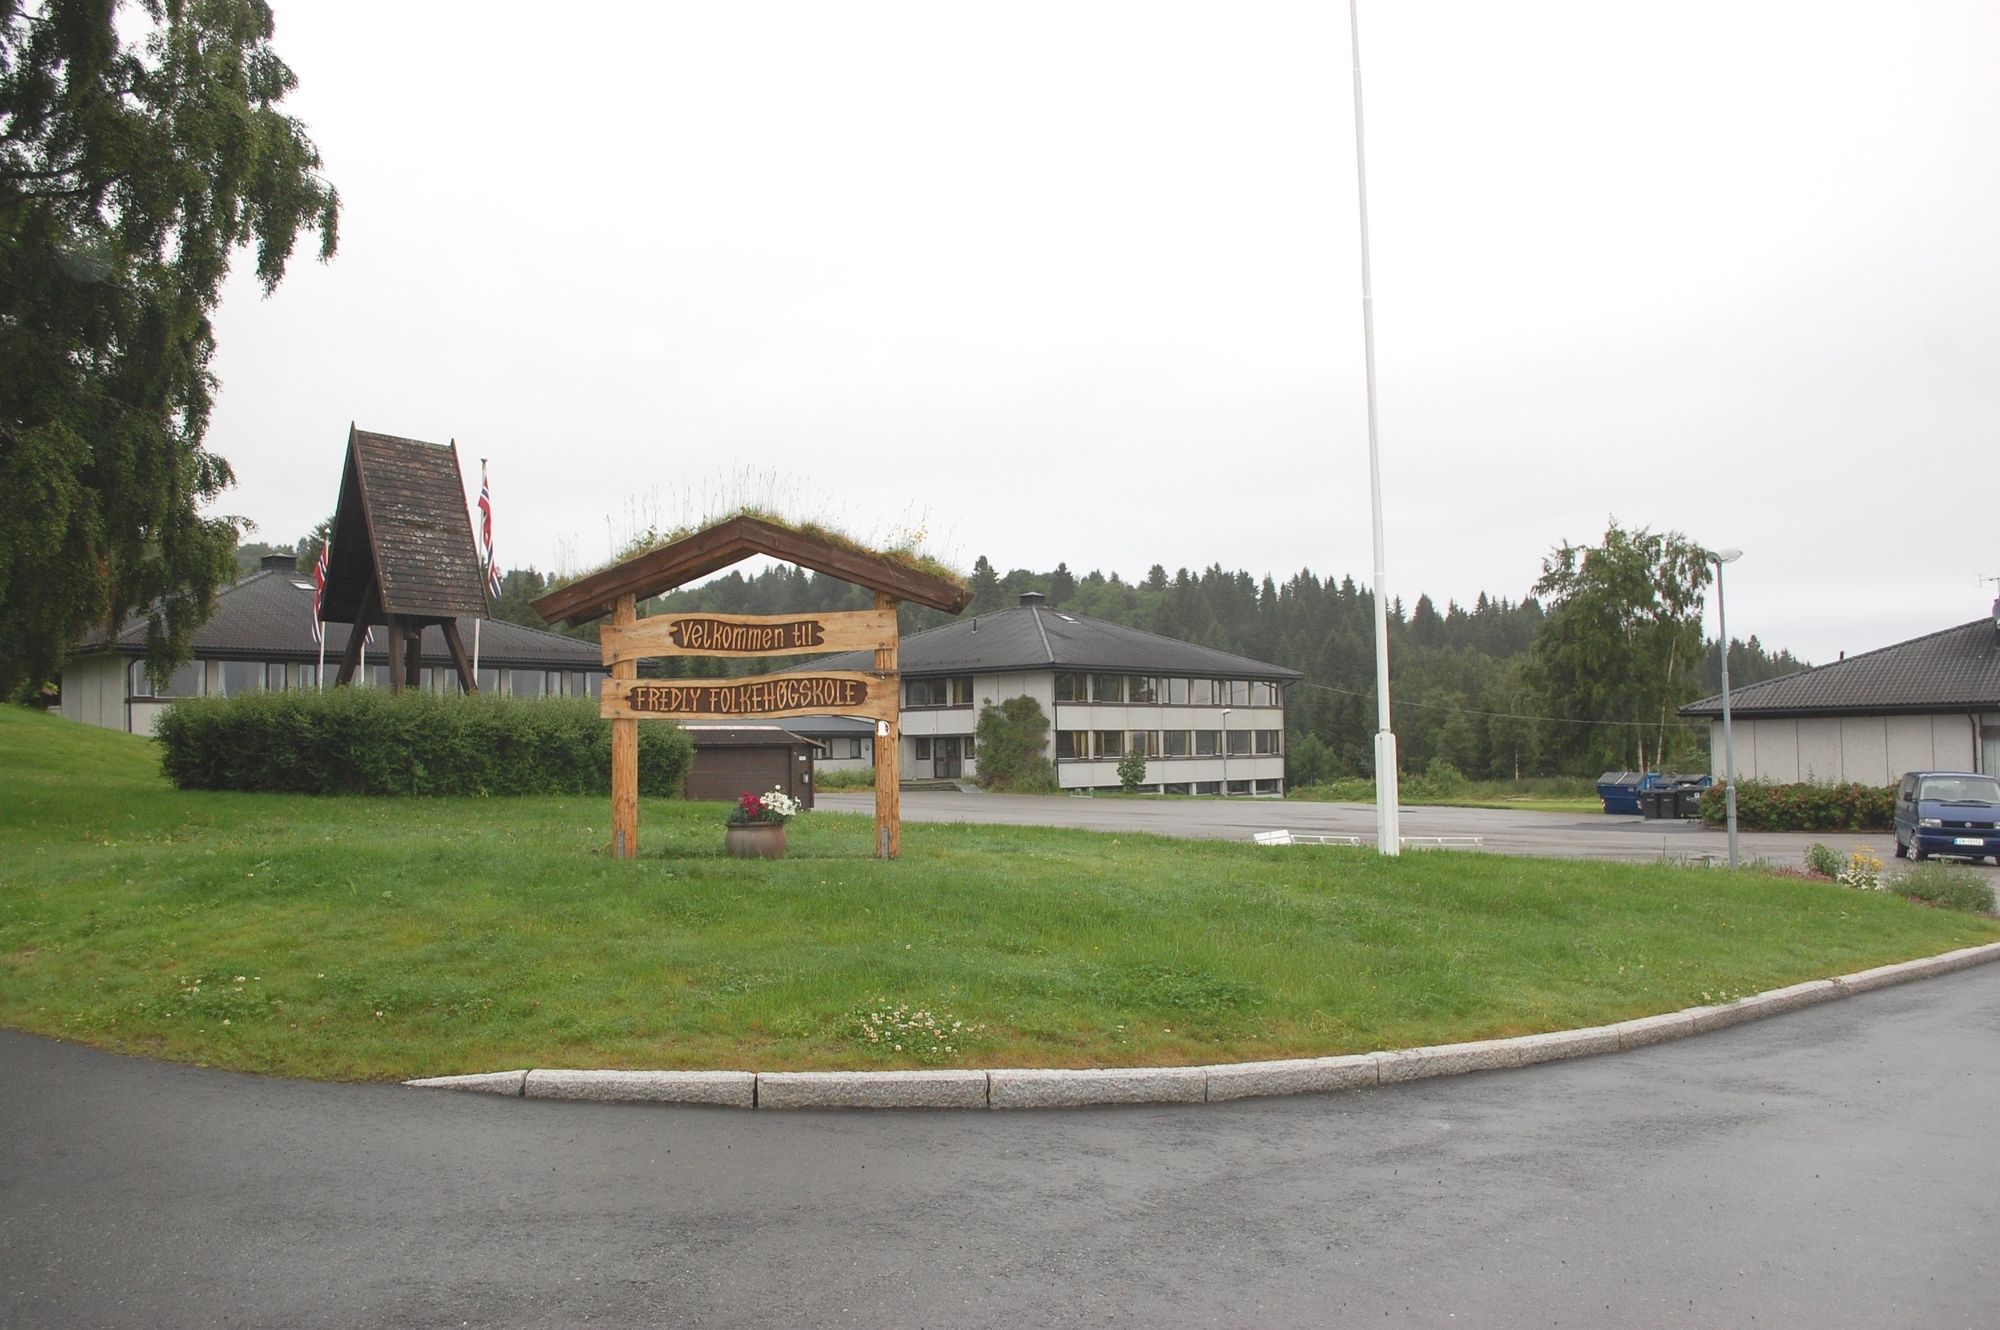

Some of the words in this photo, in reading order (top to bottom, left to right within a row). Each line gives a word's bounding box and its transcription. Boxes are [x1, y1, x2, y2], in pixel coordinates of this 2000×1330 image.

[680, 621, 784, 650] Velkommen
[793, 623, 812, 646] til
[637, 687, 701, 712] FREDLY
[709, 680, 857, 713] FOLKEHØGSKOLE
